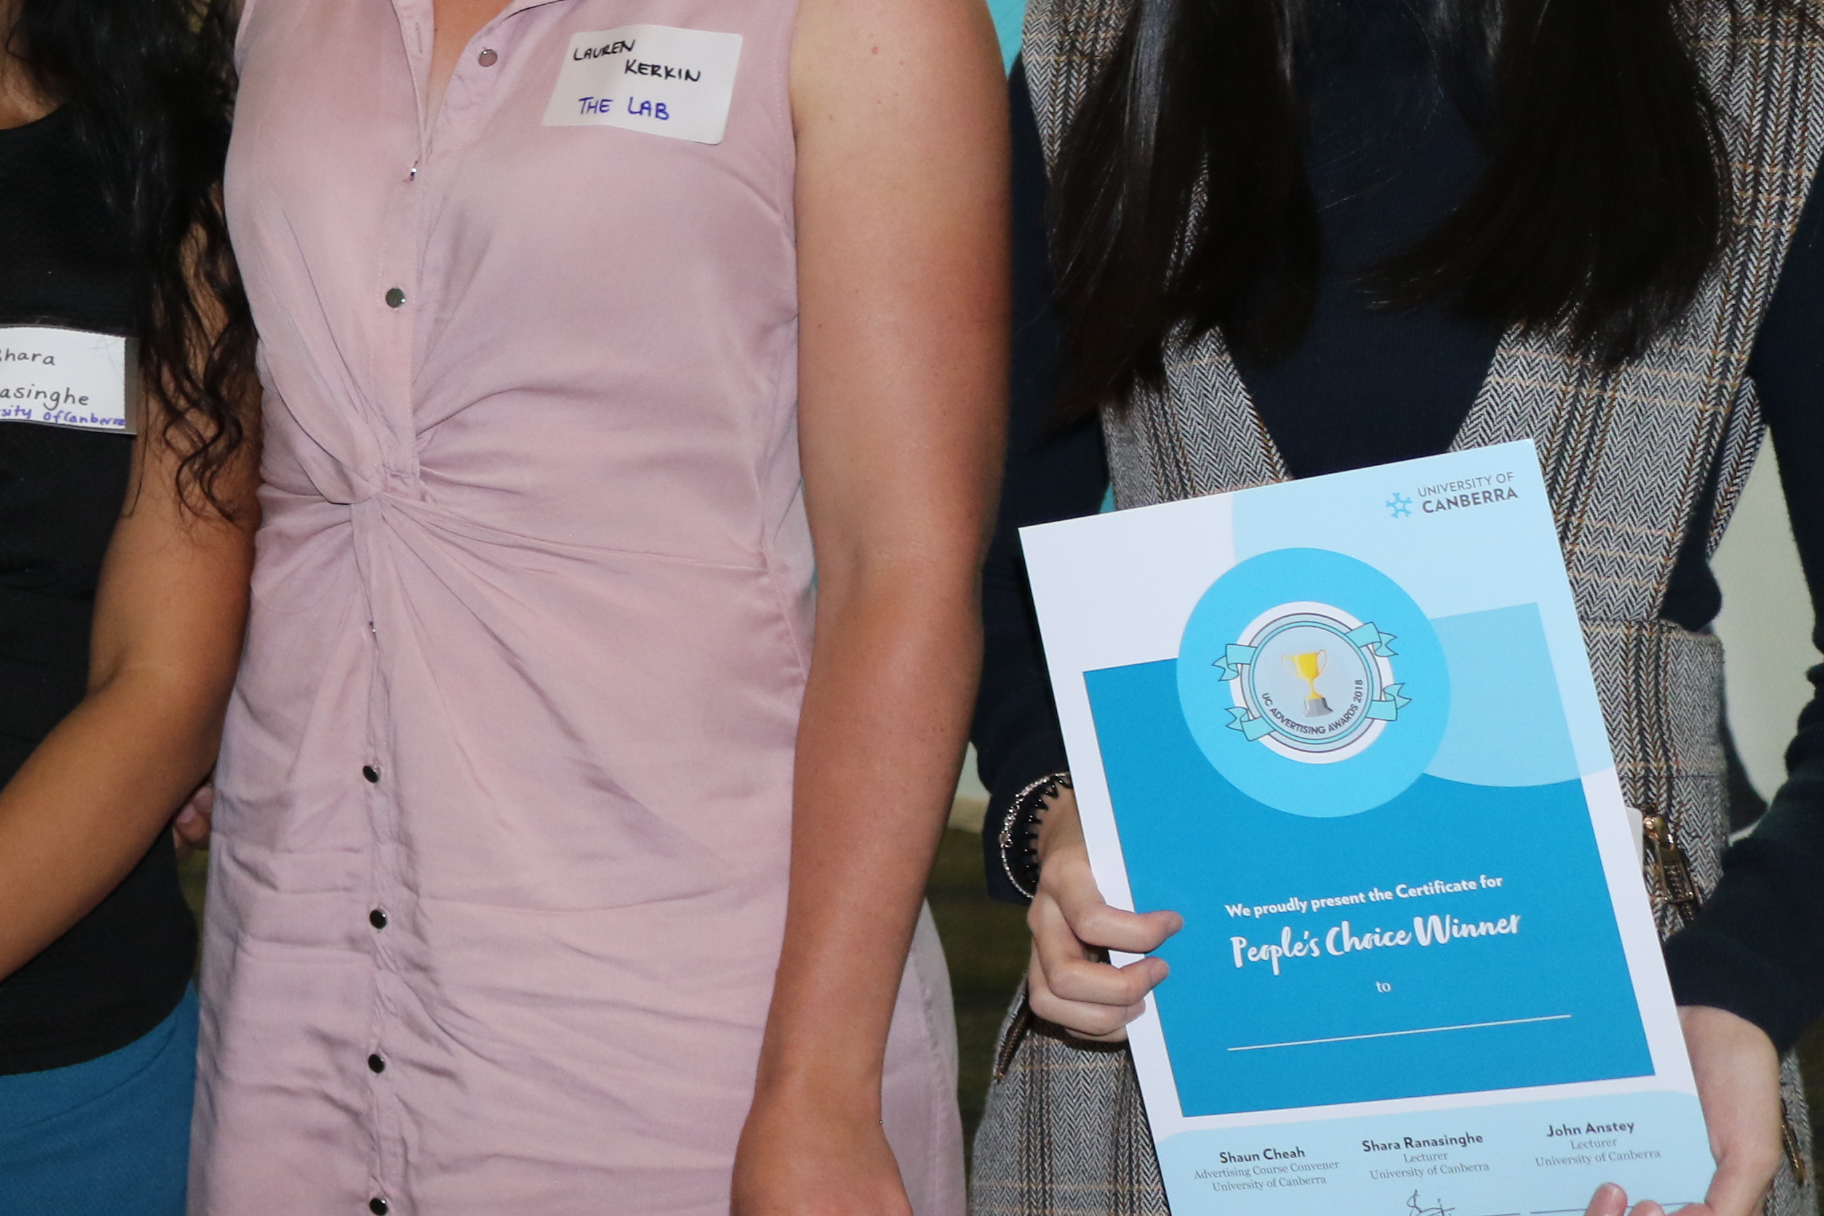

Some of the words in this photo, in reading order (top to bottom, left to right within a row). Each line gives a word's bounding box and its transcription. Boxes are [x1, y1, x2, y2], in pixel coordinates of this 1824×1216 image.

[573, 39, 636, 61] LAUREN
[624, 59, 701, 82] KERKIN
[578, 96, 614, 115] THE
[627, 96, 670, 121] LAB
[1417, 475, 1492, 497] UNIVERSITY
[1495, 471, 1515, 484] OF
[1422, 486, 1519, 514] CANBERRA
[1262, 692, 1273, 707] UC
[1270, 707, 1326, 735] ADVERTISING
[1328, 703, 1359, 732] AWARDS
[1353, 679, 1363, 704] 2018
[1224, 903, 1251, 918] We
[1253, 896, 1308, 919] proudly
[1310, 892, 1366, 912] present
[1368, 887, 1394, 903] the
[1395, 878, 1477, 899] Certificate
[1479, 874, 1503, 889] for
[1230, 925, 1321, 977] People's
[1325, 920, 1412, 957] Choice
[1413, 913, 1522, 948] Winner
[1376, 981, 1392, 993] to
[1546, 1124, 1582, 1138] John
[1585, 1121, 1635, 1135] Anstey
[1362, 1140, 1401, 1153] Shara
[1404, 1133, 1483, 1149] Ranasinghe
[1570, 1137, 1618, 1151] Lecturer
[1219, 1151, 1260, 1164] Shaun
[1263, 1146, 1306, 1161] Cheah
[1403, 1151, 1448, 1164] Lecturer
[1535, 1153, 1592, 1168] University
[1594, 1151, 1607, 1163] of
[1608, 1148, 1662, 1162] Canberra
[1193, 1167, 1250, 1180] Advertising
[1252, 1165, 1288, 1176] Course
[1289, 1160, 1340, 1172] Convener
[1369, 1167, 1424, 1181] University
[1426, 1165, 1438, 1176] of
[1440, 1162, 1490, 1175] Canberra
[1212, 1180, 1264, 1192] University
[1266, 1178, 1277, 1188] of
[1278, 1175, 1327, 1187] Canberra
